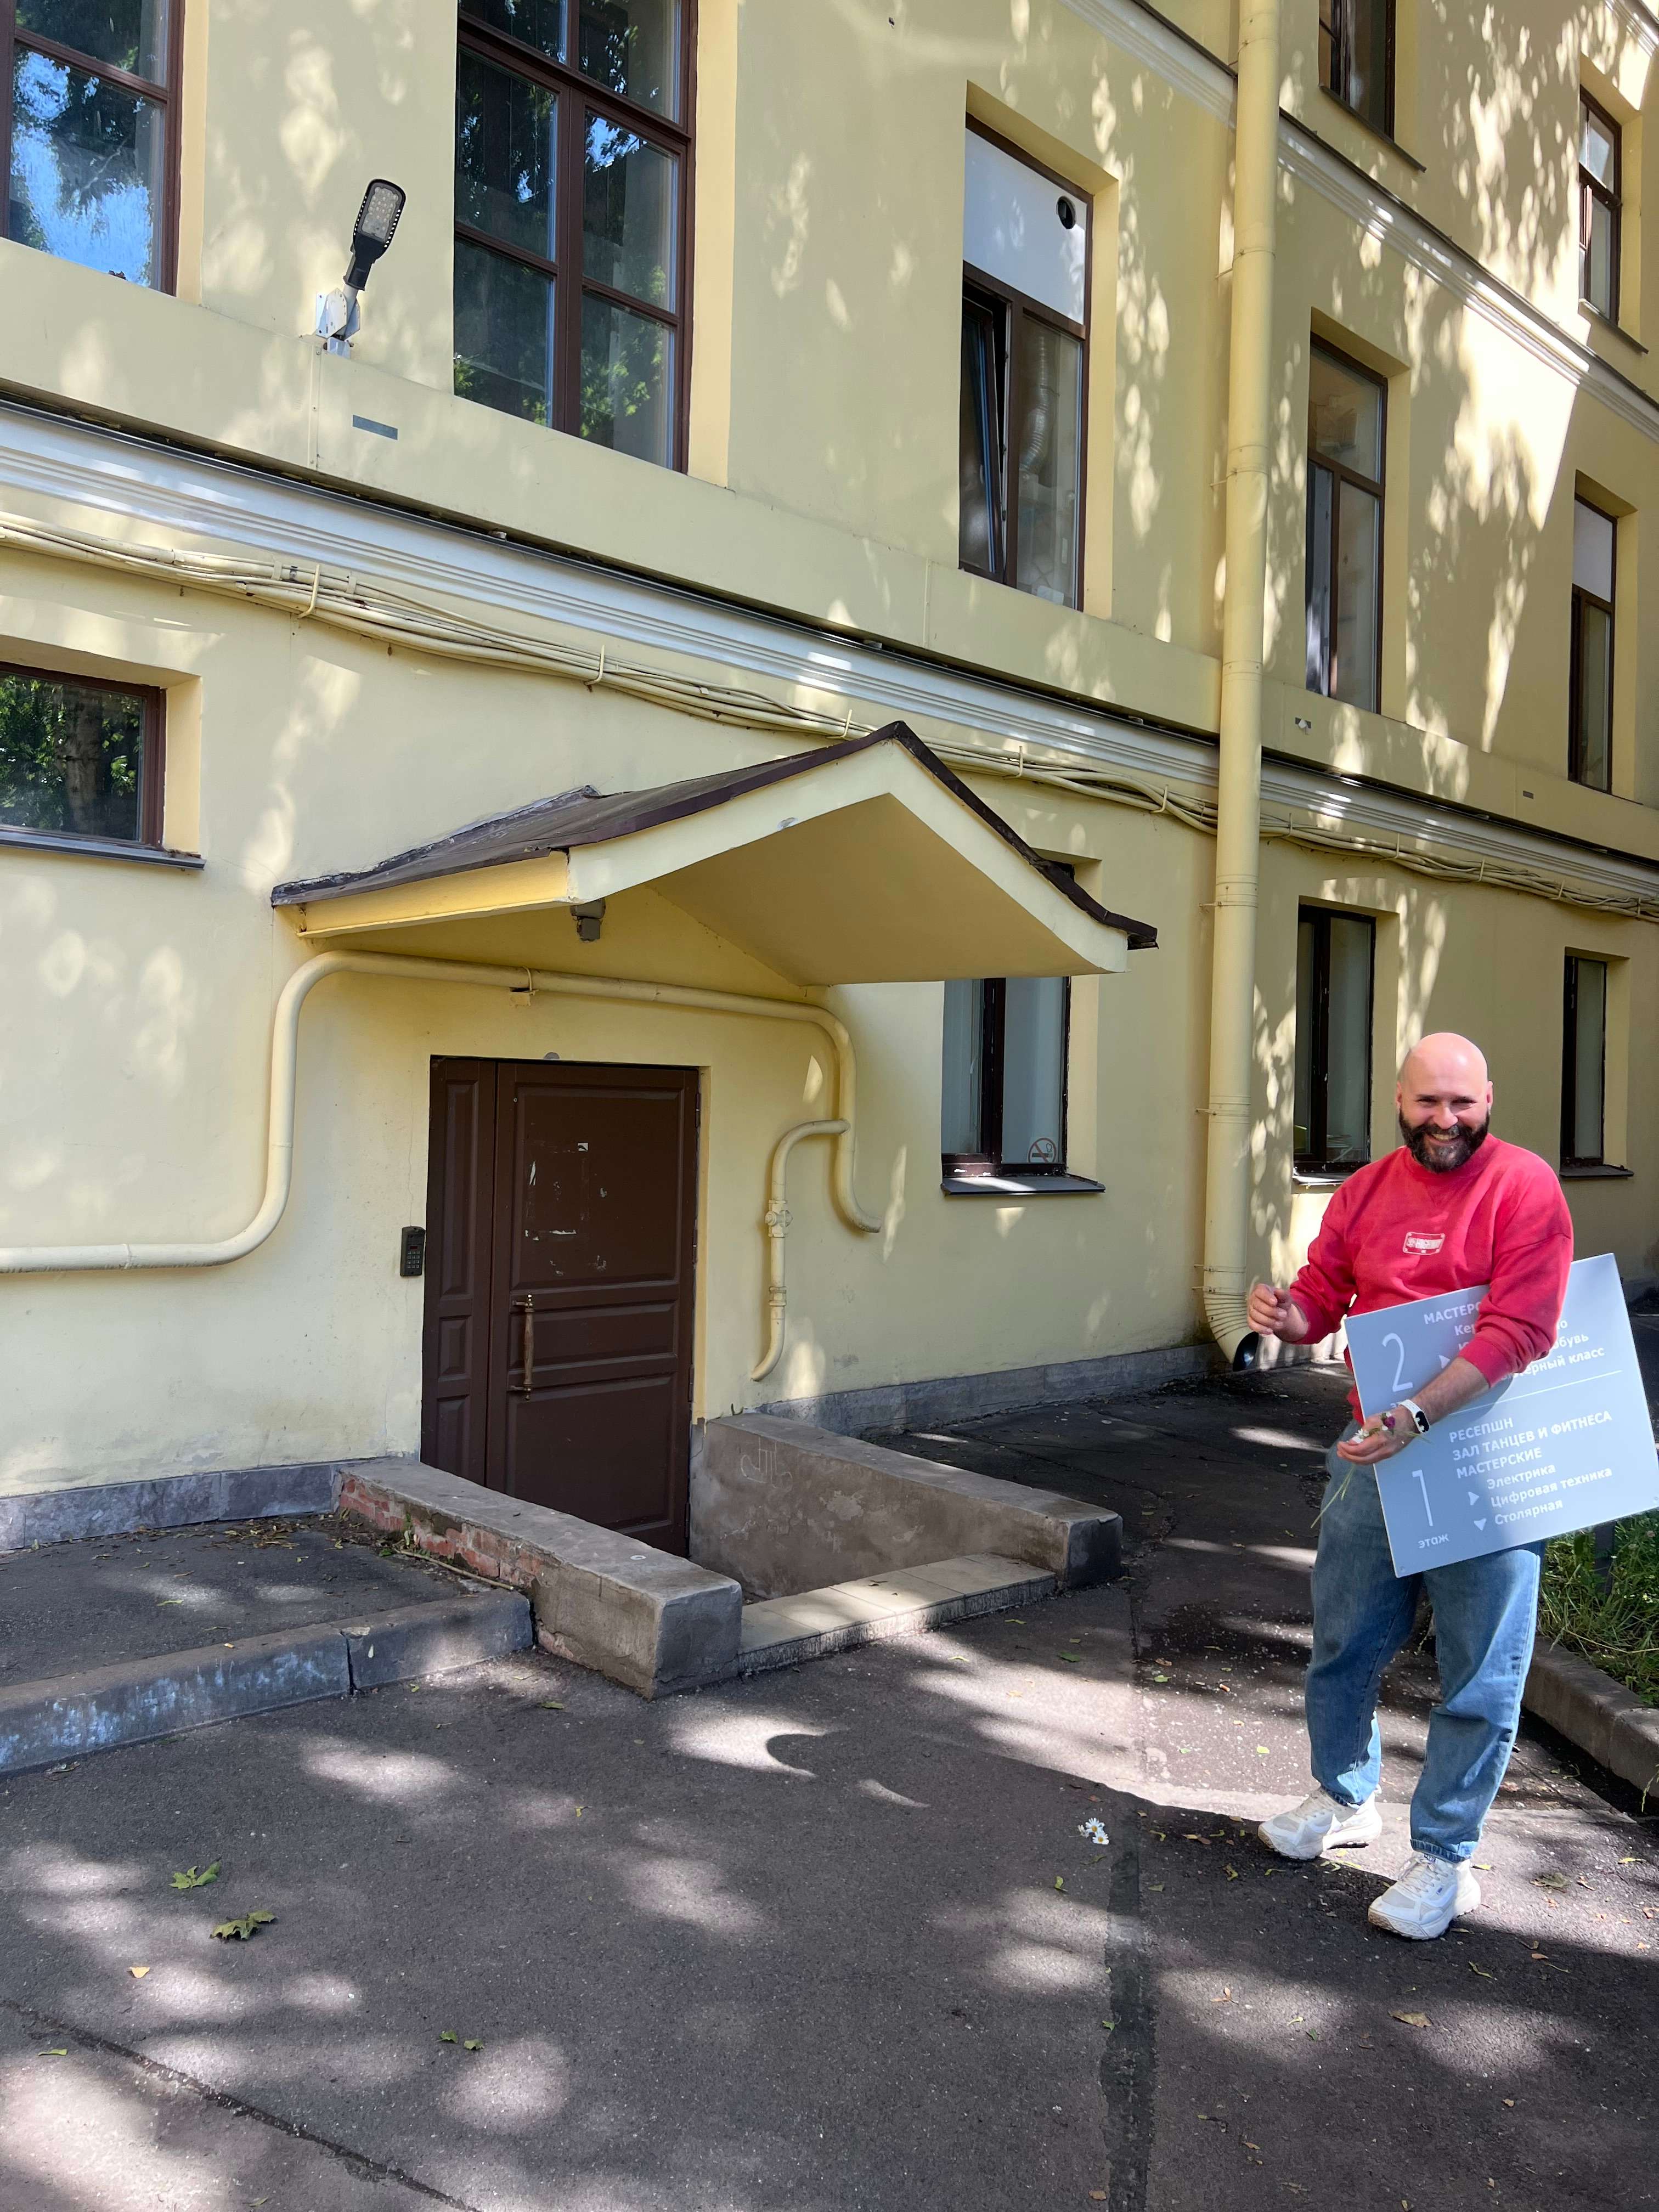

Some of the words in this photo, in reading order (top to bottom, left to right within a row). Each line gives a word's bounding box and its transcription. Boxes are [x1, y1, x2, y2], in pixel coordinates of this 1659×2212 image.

[1382, 1333, 1413, 1392] 2
[1568, 1348, 1605, 1364] класс
[1449, 1417, 1514, 1442] РЕСЕПШН
[1452, 1445, 1480, 1460] ЗАЛ
[1482, 1430, 1534, 1453] ТАНЦЕВ
[1537, 1426, 1548, 1439] И
[1551, 1410, 1612, 1435] ФИТНЕСА
[1457, 1447, 1542, 1479] МАСТЕРСКИЕ
[1487, 1464, 1556, 1489] Электрика
[1412, 1470, 1433, 1526] 1
[1491, 1482, 1558, 1508] Цифровая
[1560, 1468, 1612, 1489] техника
[1494, 1499, 1563, 1525] Столярная
[1418, 1533, 1449, 1549] этаж
